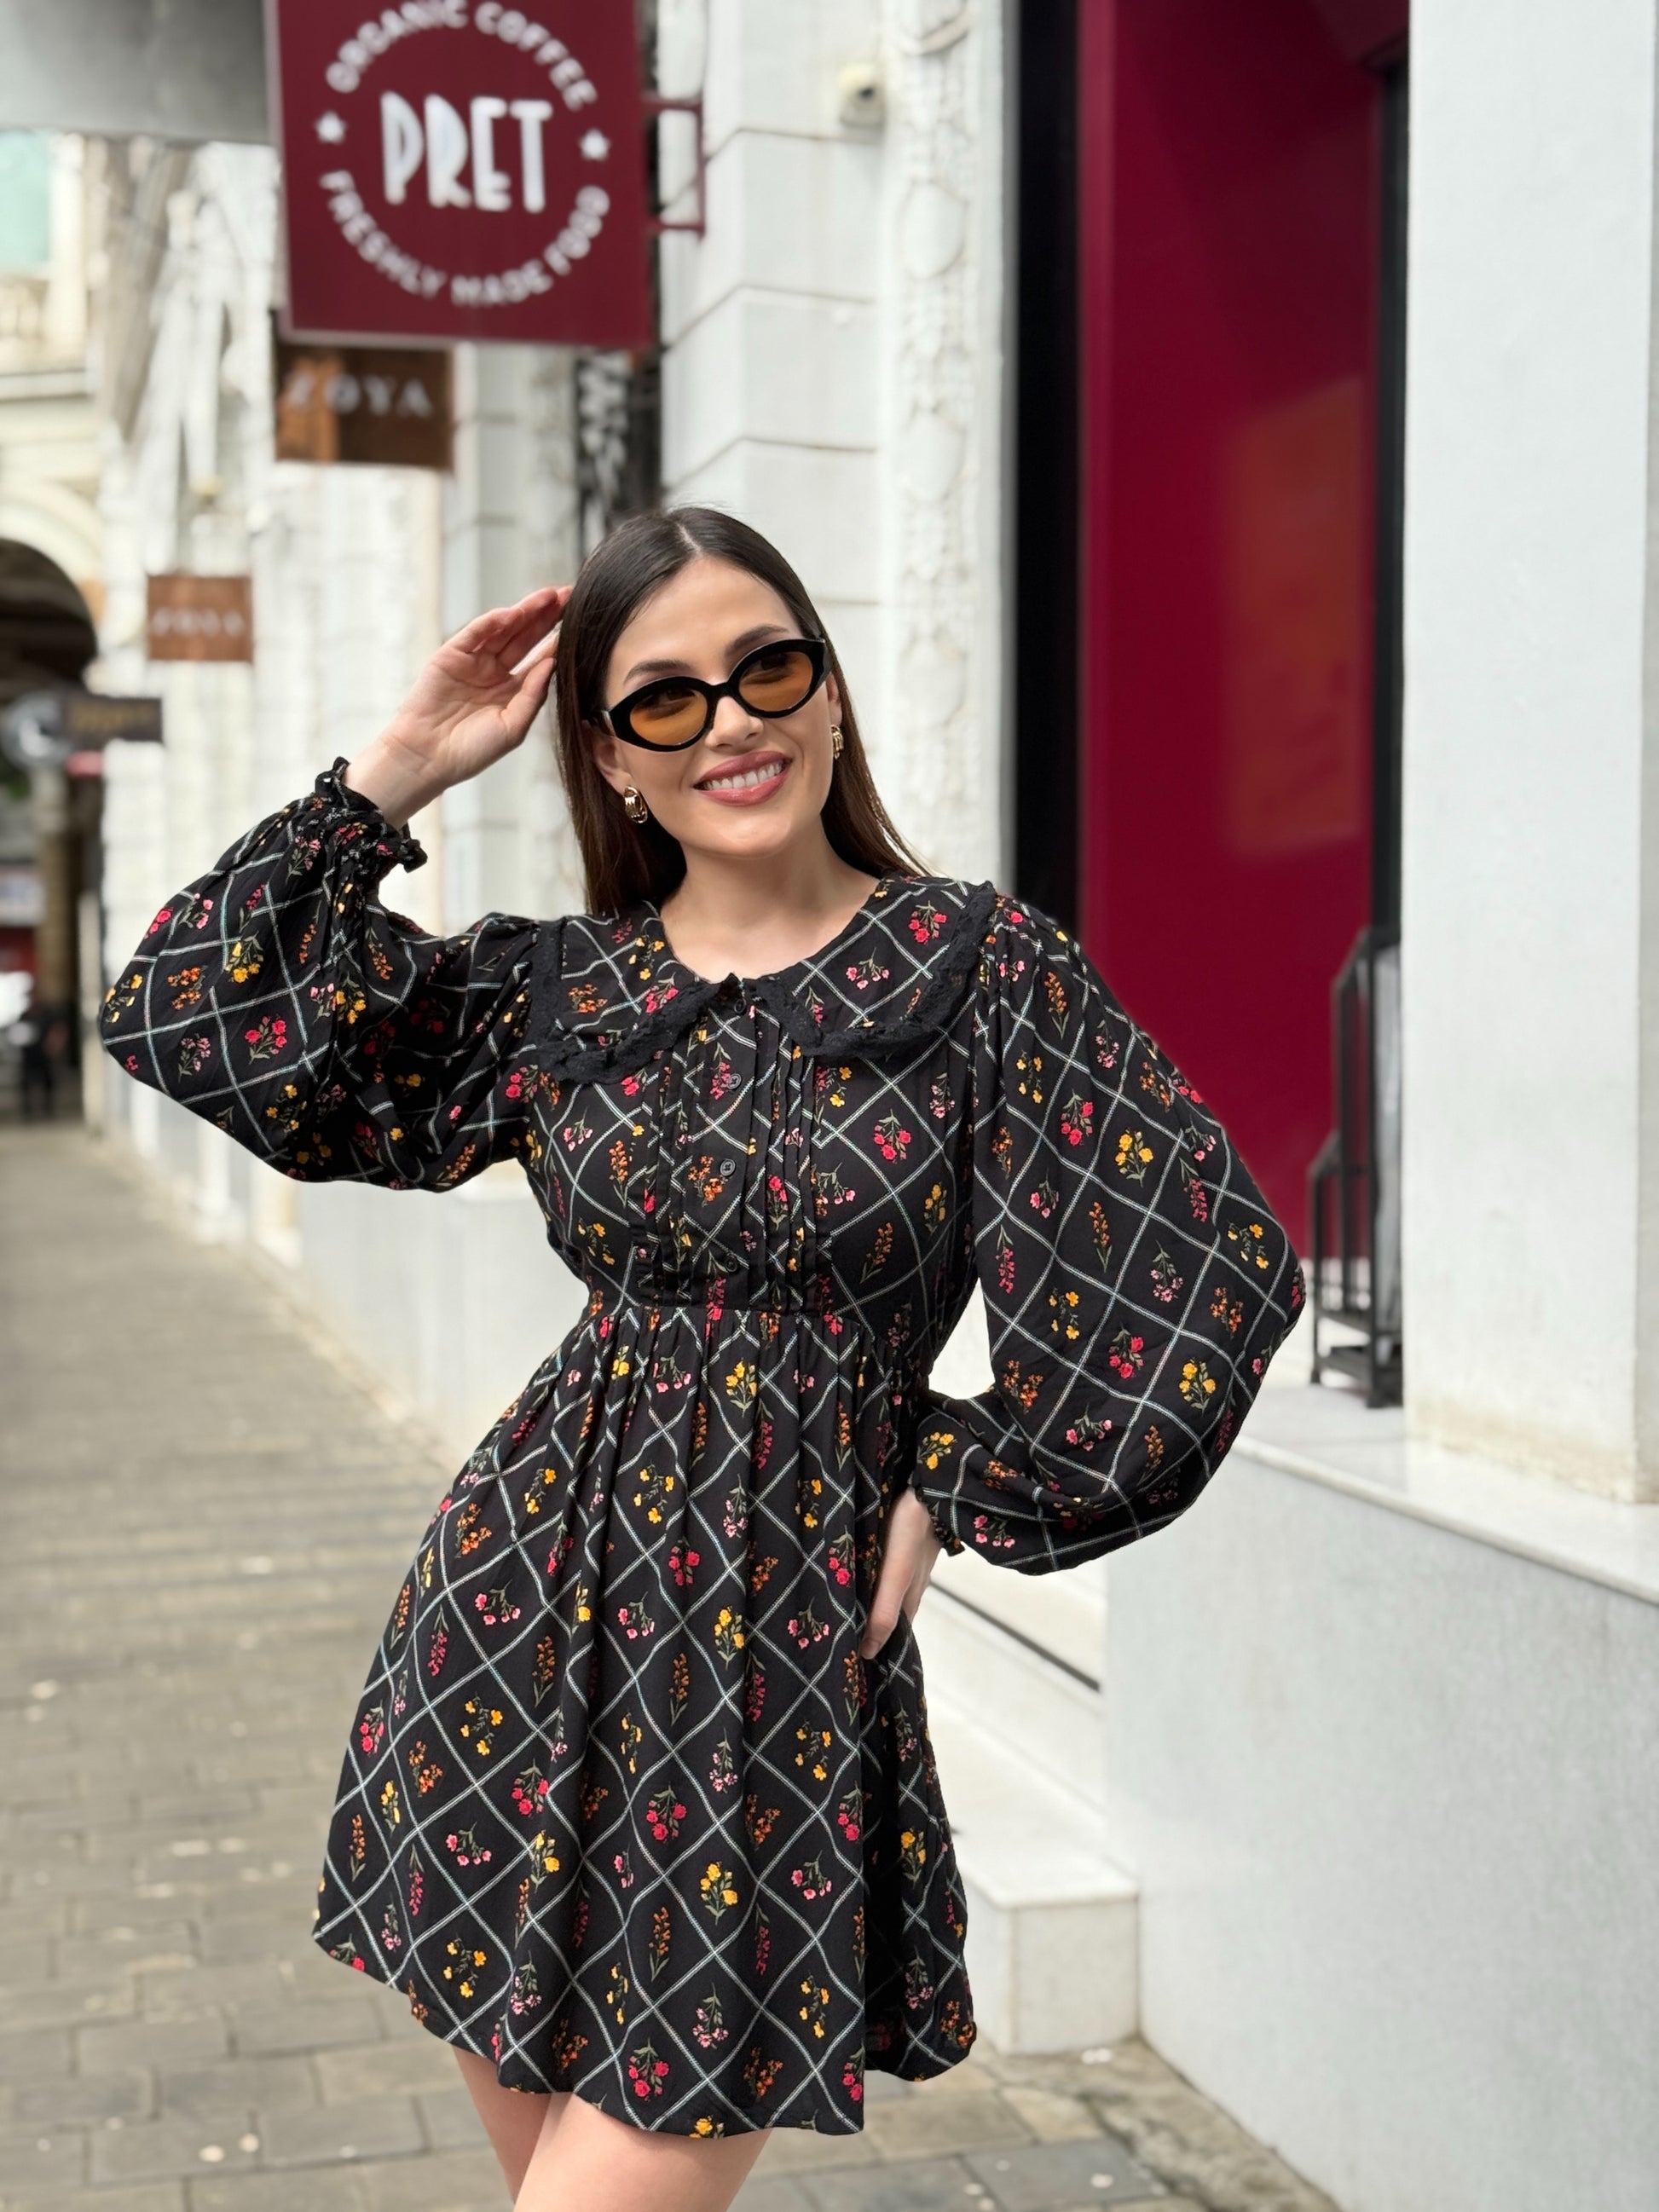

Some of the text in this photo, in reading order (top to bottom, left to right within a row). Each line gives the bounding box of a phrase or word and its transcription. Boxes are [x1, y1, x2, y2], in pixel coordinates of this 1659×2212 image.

[325, 0, 598, 112] ORGANIC COFFEE
[380, 90, 553, 214] PRET
[320, 170, 610, 307] FRESHLY MADE FOOD
